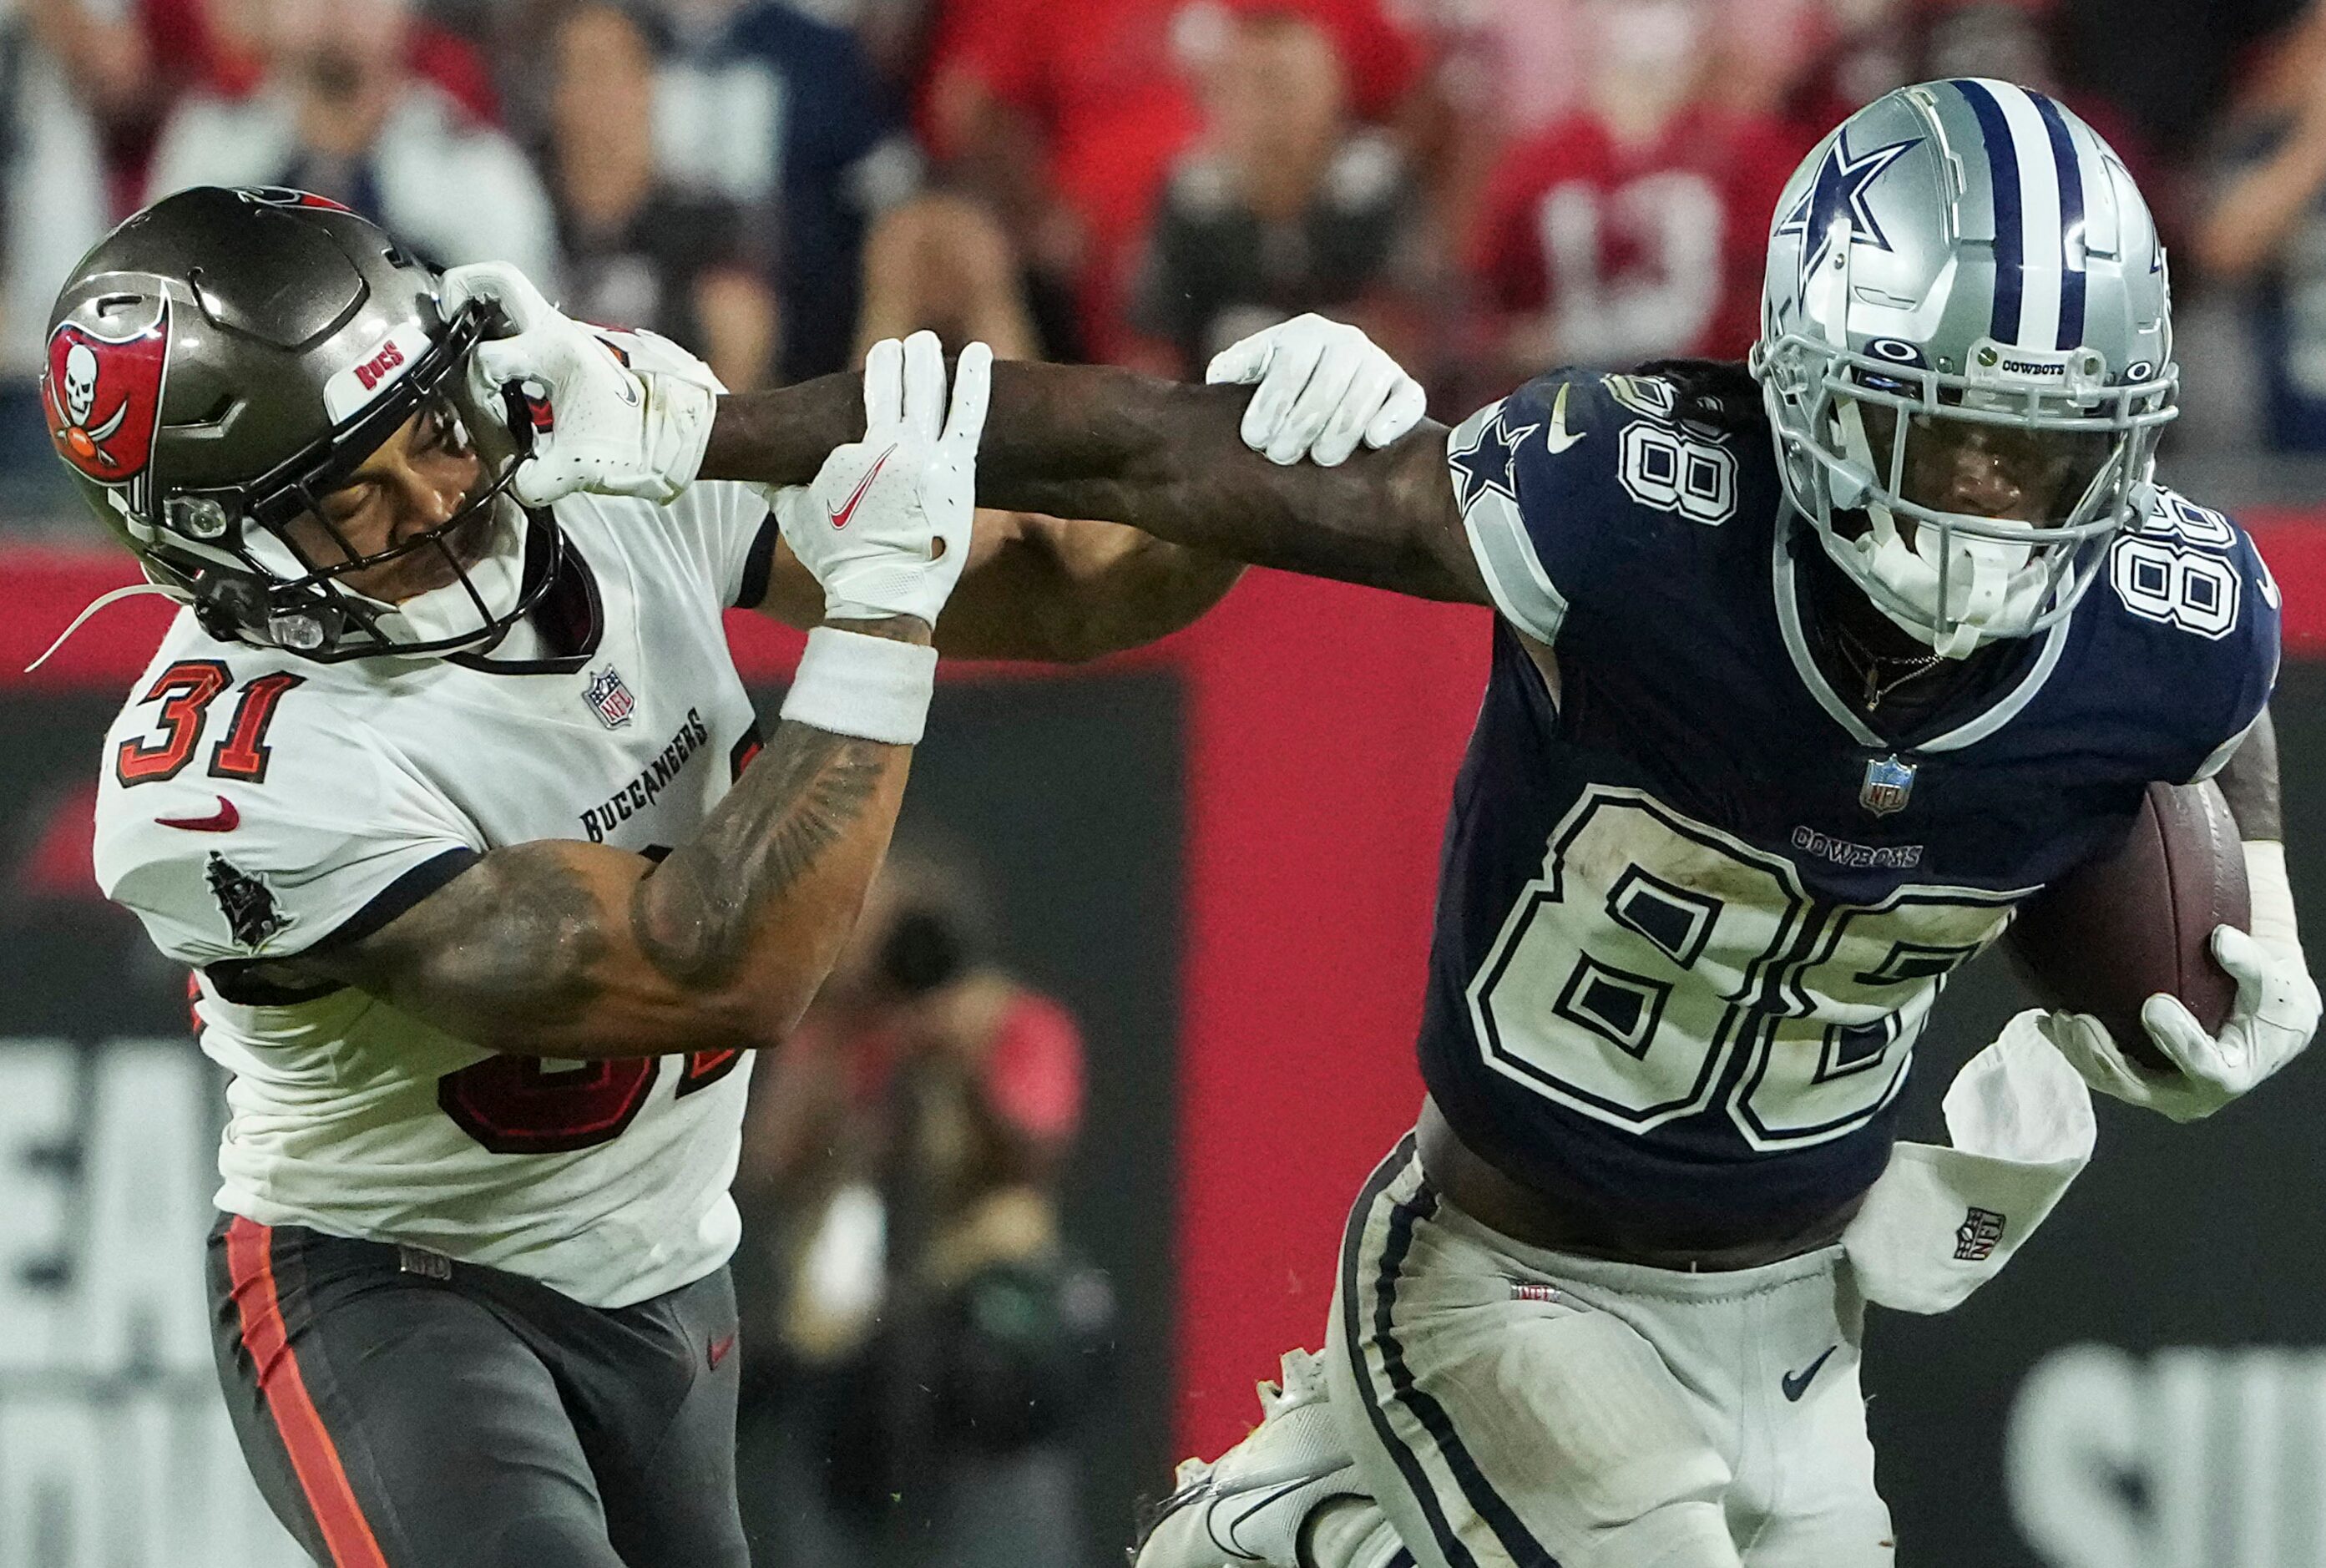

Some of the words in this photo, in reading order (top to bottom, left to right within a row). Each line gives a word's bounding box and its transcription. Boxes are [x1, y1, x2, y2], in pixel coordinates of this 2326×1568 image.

[2001, 359, 2065, 376] COWBOYS
[116, 659, 309, 789] 31
[601, 690, 632, 721] NFL
[579, 706, 709, 844] BUCCANEERS
[1869, 785, 1902, 807] NFL
[1791, 825, 1924, 868] COWBOYS
[1970, 1216, 2003, 1256] NFL
